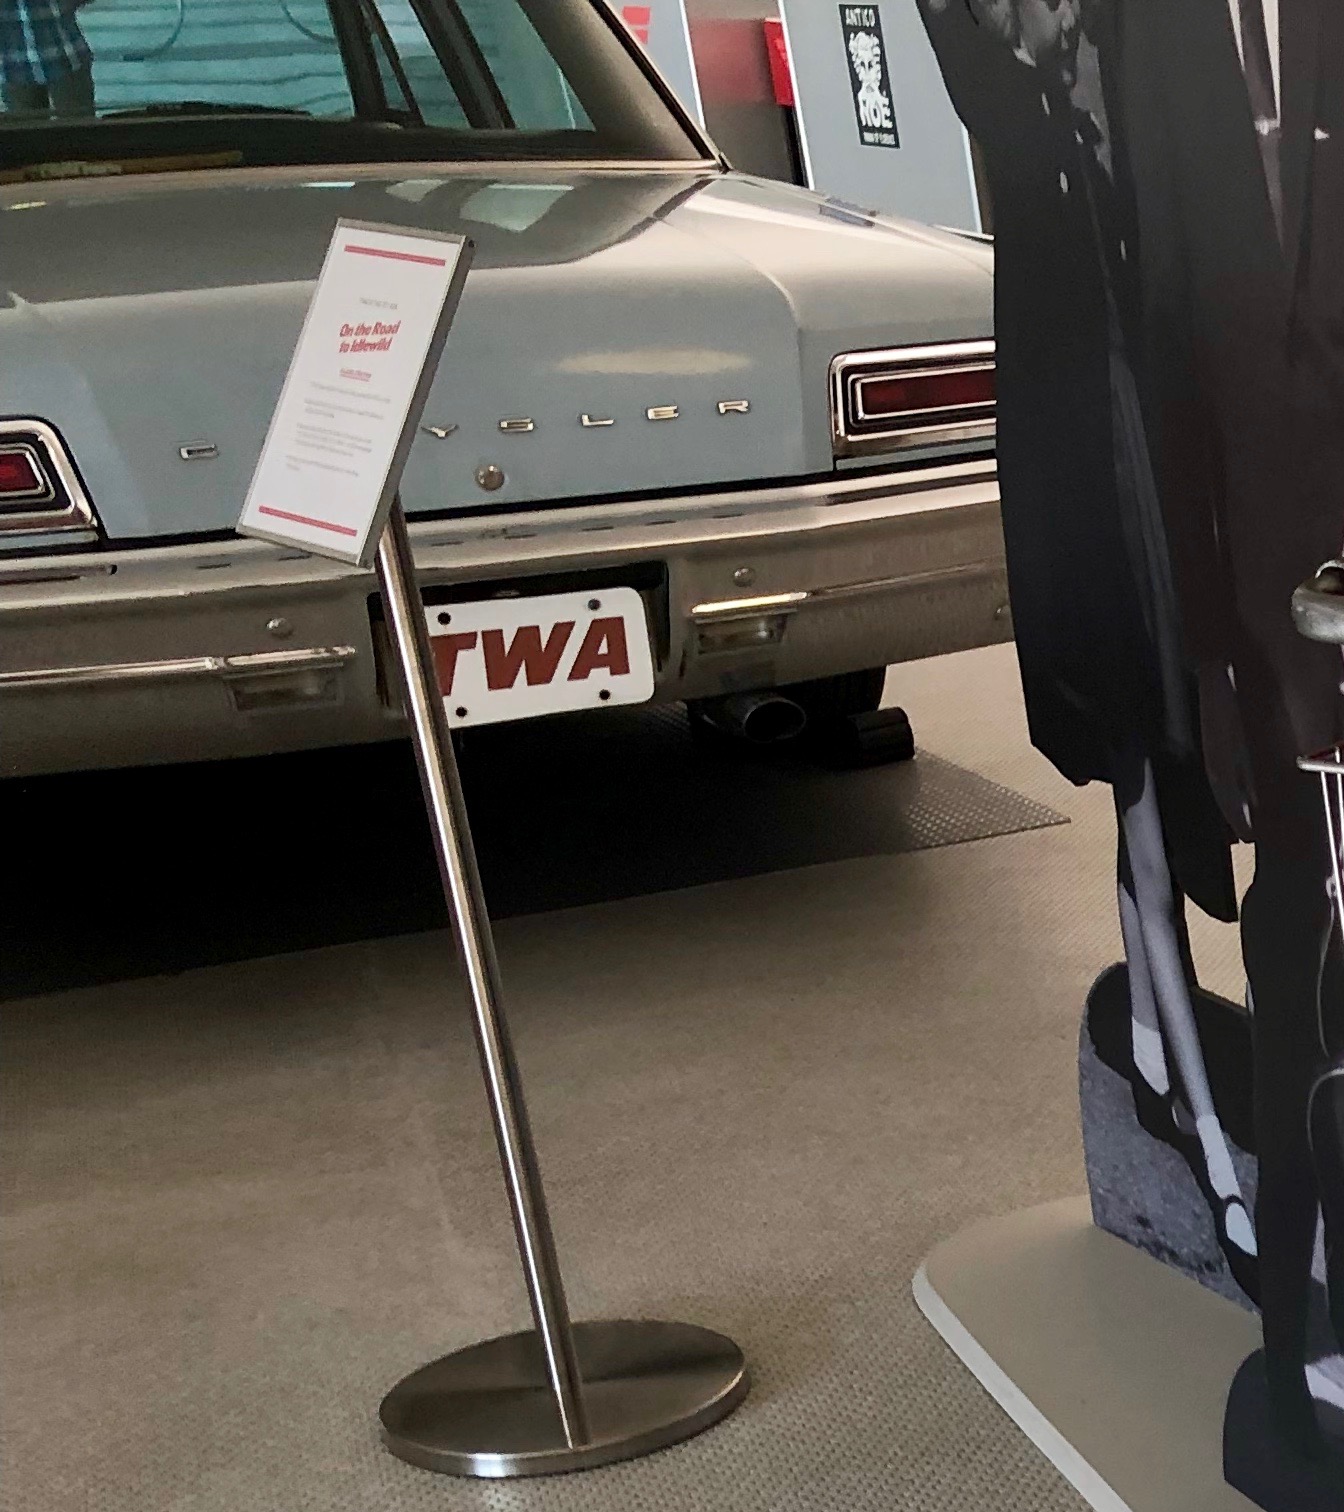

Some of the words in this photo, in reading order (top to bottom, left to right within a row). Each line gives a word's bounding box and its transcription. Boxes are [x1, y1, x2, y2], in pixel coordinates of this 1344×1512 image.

[339, 323, 354, 337] On
[354, 321, 372, 336] the
[371, 319, 402, 335] Road
[339, 341, 350, 353] to
[430, 616, 631, 697] TWA
